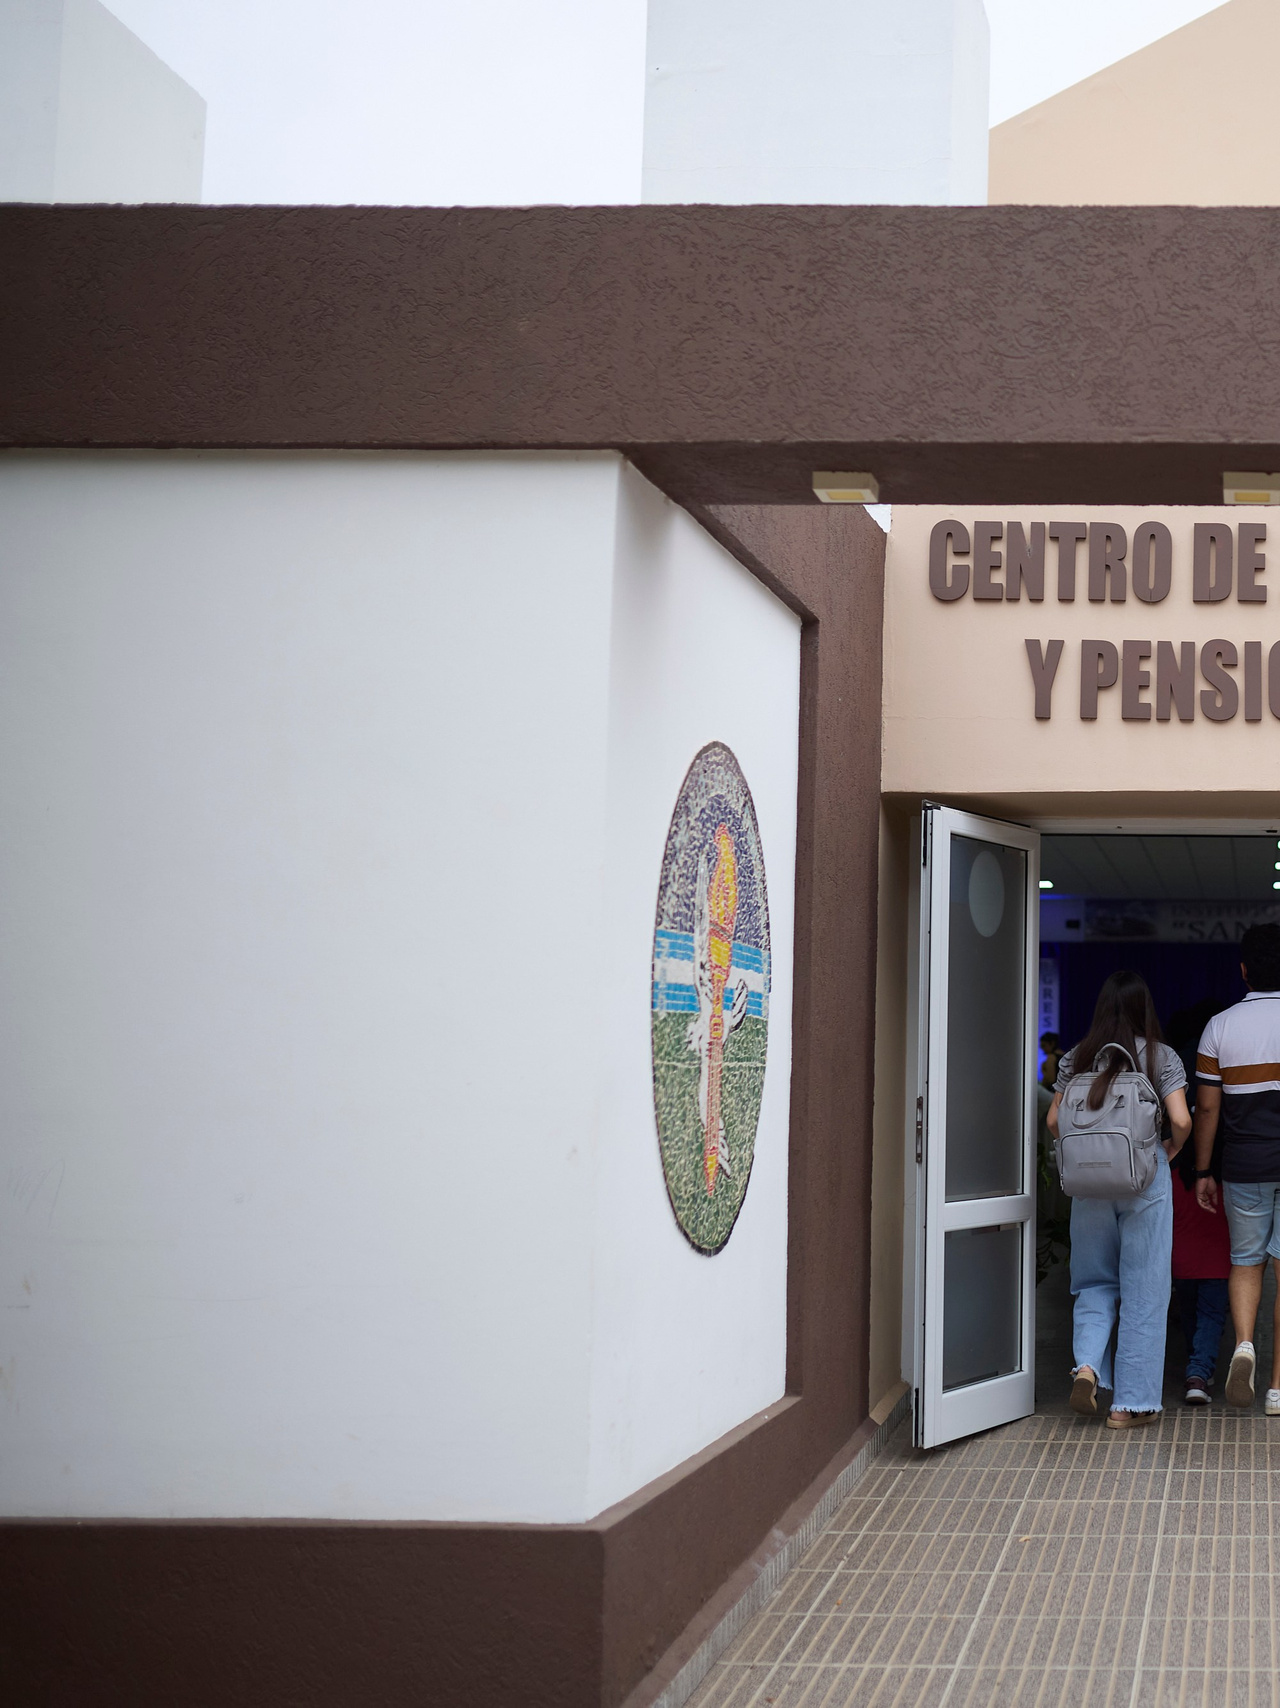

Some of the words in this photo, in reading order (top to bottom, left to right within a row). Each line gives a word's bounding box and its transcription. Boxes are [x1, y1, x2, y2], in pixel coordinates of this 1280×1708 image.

[928, 519, 1173, 604] CENTRO
[1192, 522, 1267, 604] DE
[1024, 638, 1065, 721] Y
